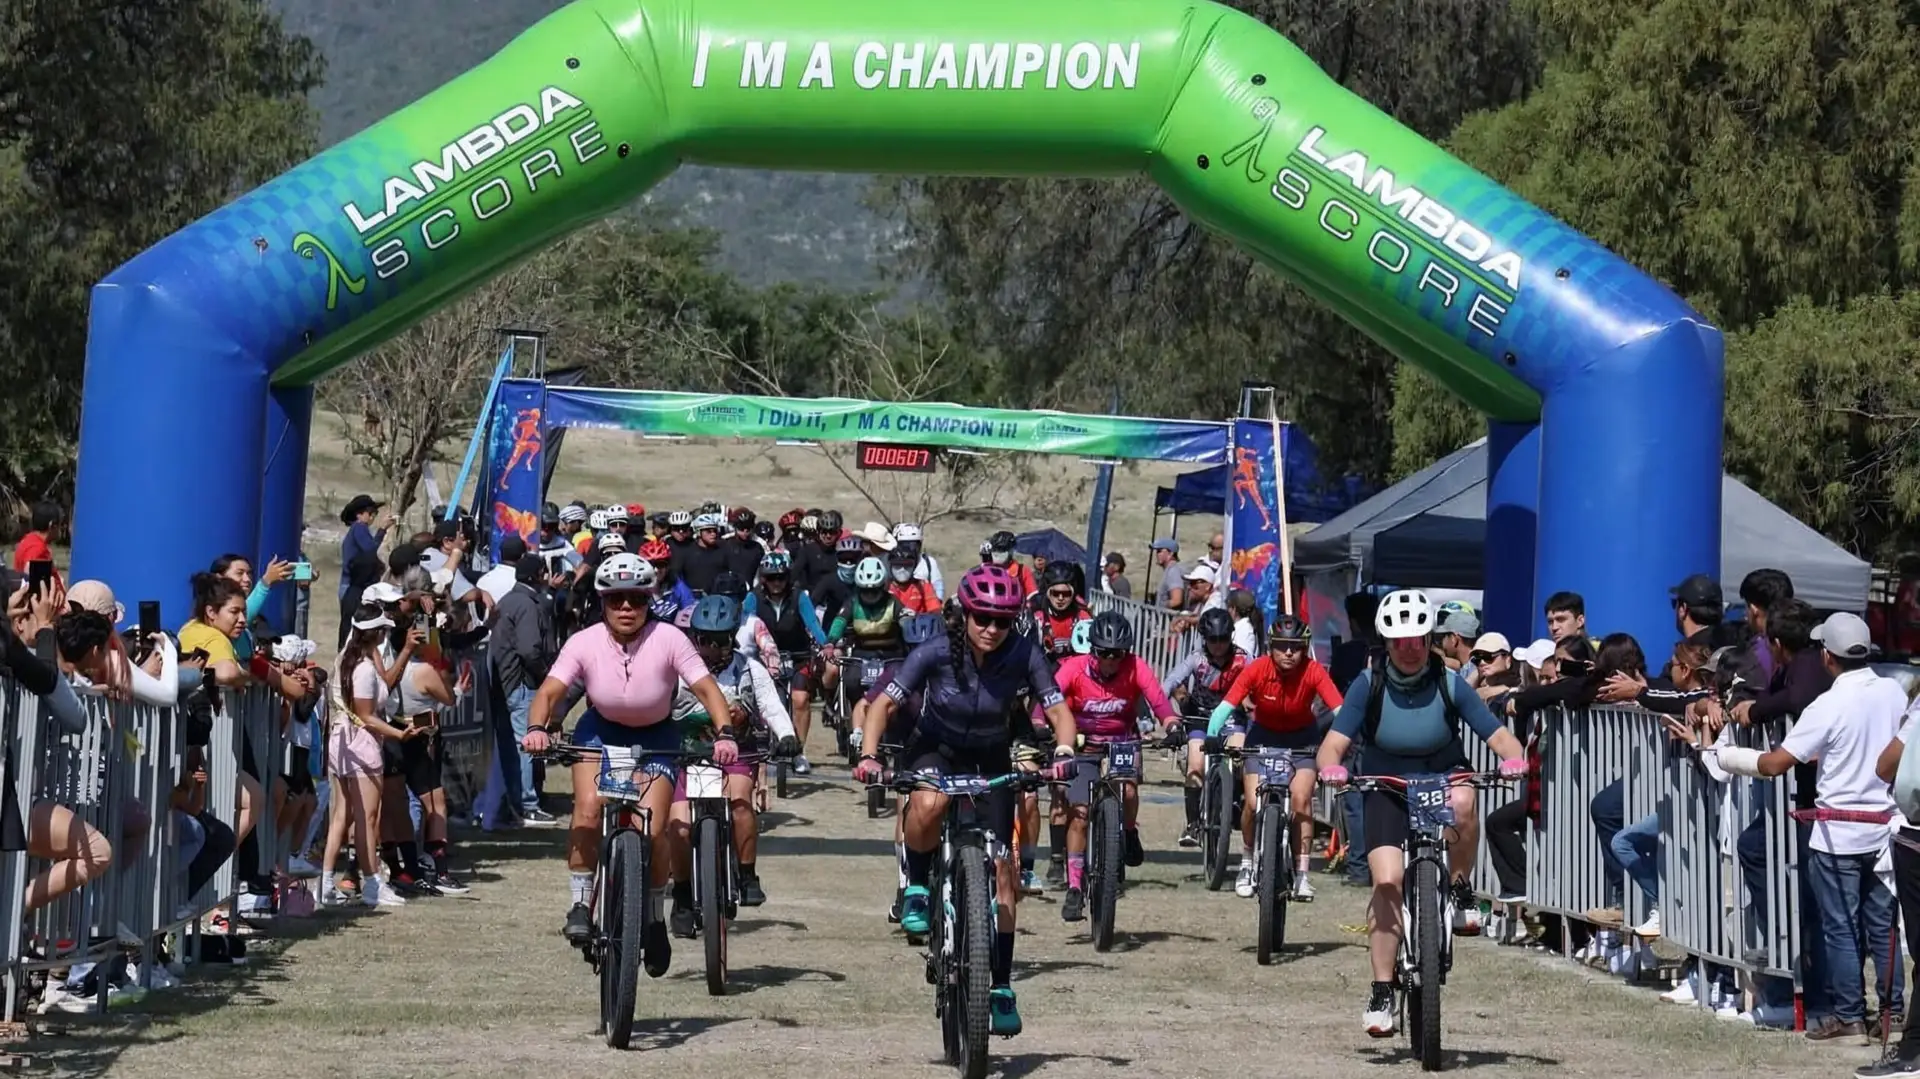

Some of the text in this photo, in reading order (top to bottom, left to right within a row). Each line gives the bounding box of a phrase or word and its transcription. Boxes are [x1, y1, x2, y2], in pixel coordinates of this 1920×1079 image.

[692, 30, 1141, 90] I M A CHAMPION
[343, 86, 585, 234] LAMBDA
[369, 121, 608, 281] SCORE
[1296, 126, 1524, 291] LAMBDA
[1272, 167, 1508, 338] SCORE
[758, 409, 765, 425] I
[769, 409, 802, 427] DID
[858, 412, 874, 430] M
[878, 414, 891, 430] A
[896, 415, 993, 438] CHAMPION
